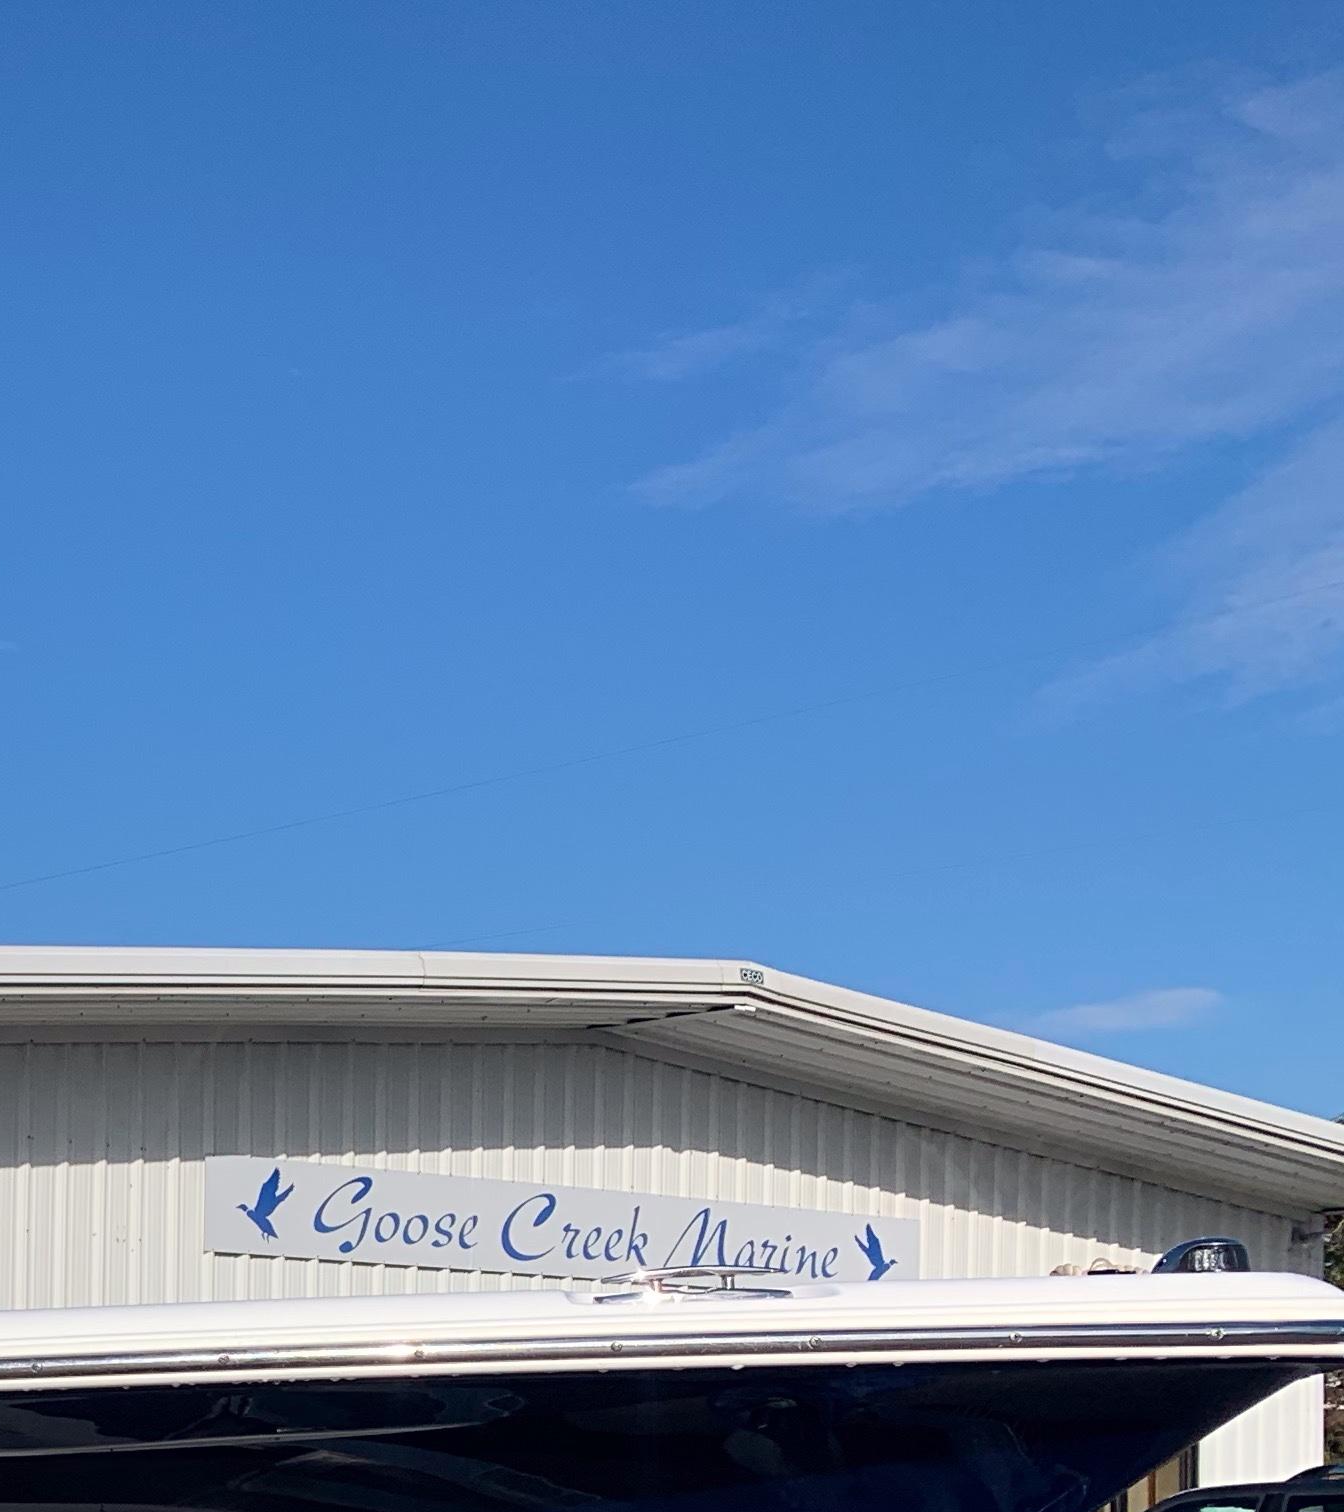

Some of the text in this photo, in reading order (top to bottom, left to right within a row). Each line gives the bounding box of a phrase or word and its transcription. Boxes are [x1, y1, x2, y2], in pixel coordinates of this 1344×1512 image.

[313, 1176, 840, 1279] Goose Creek Marine
